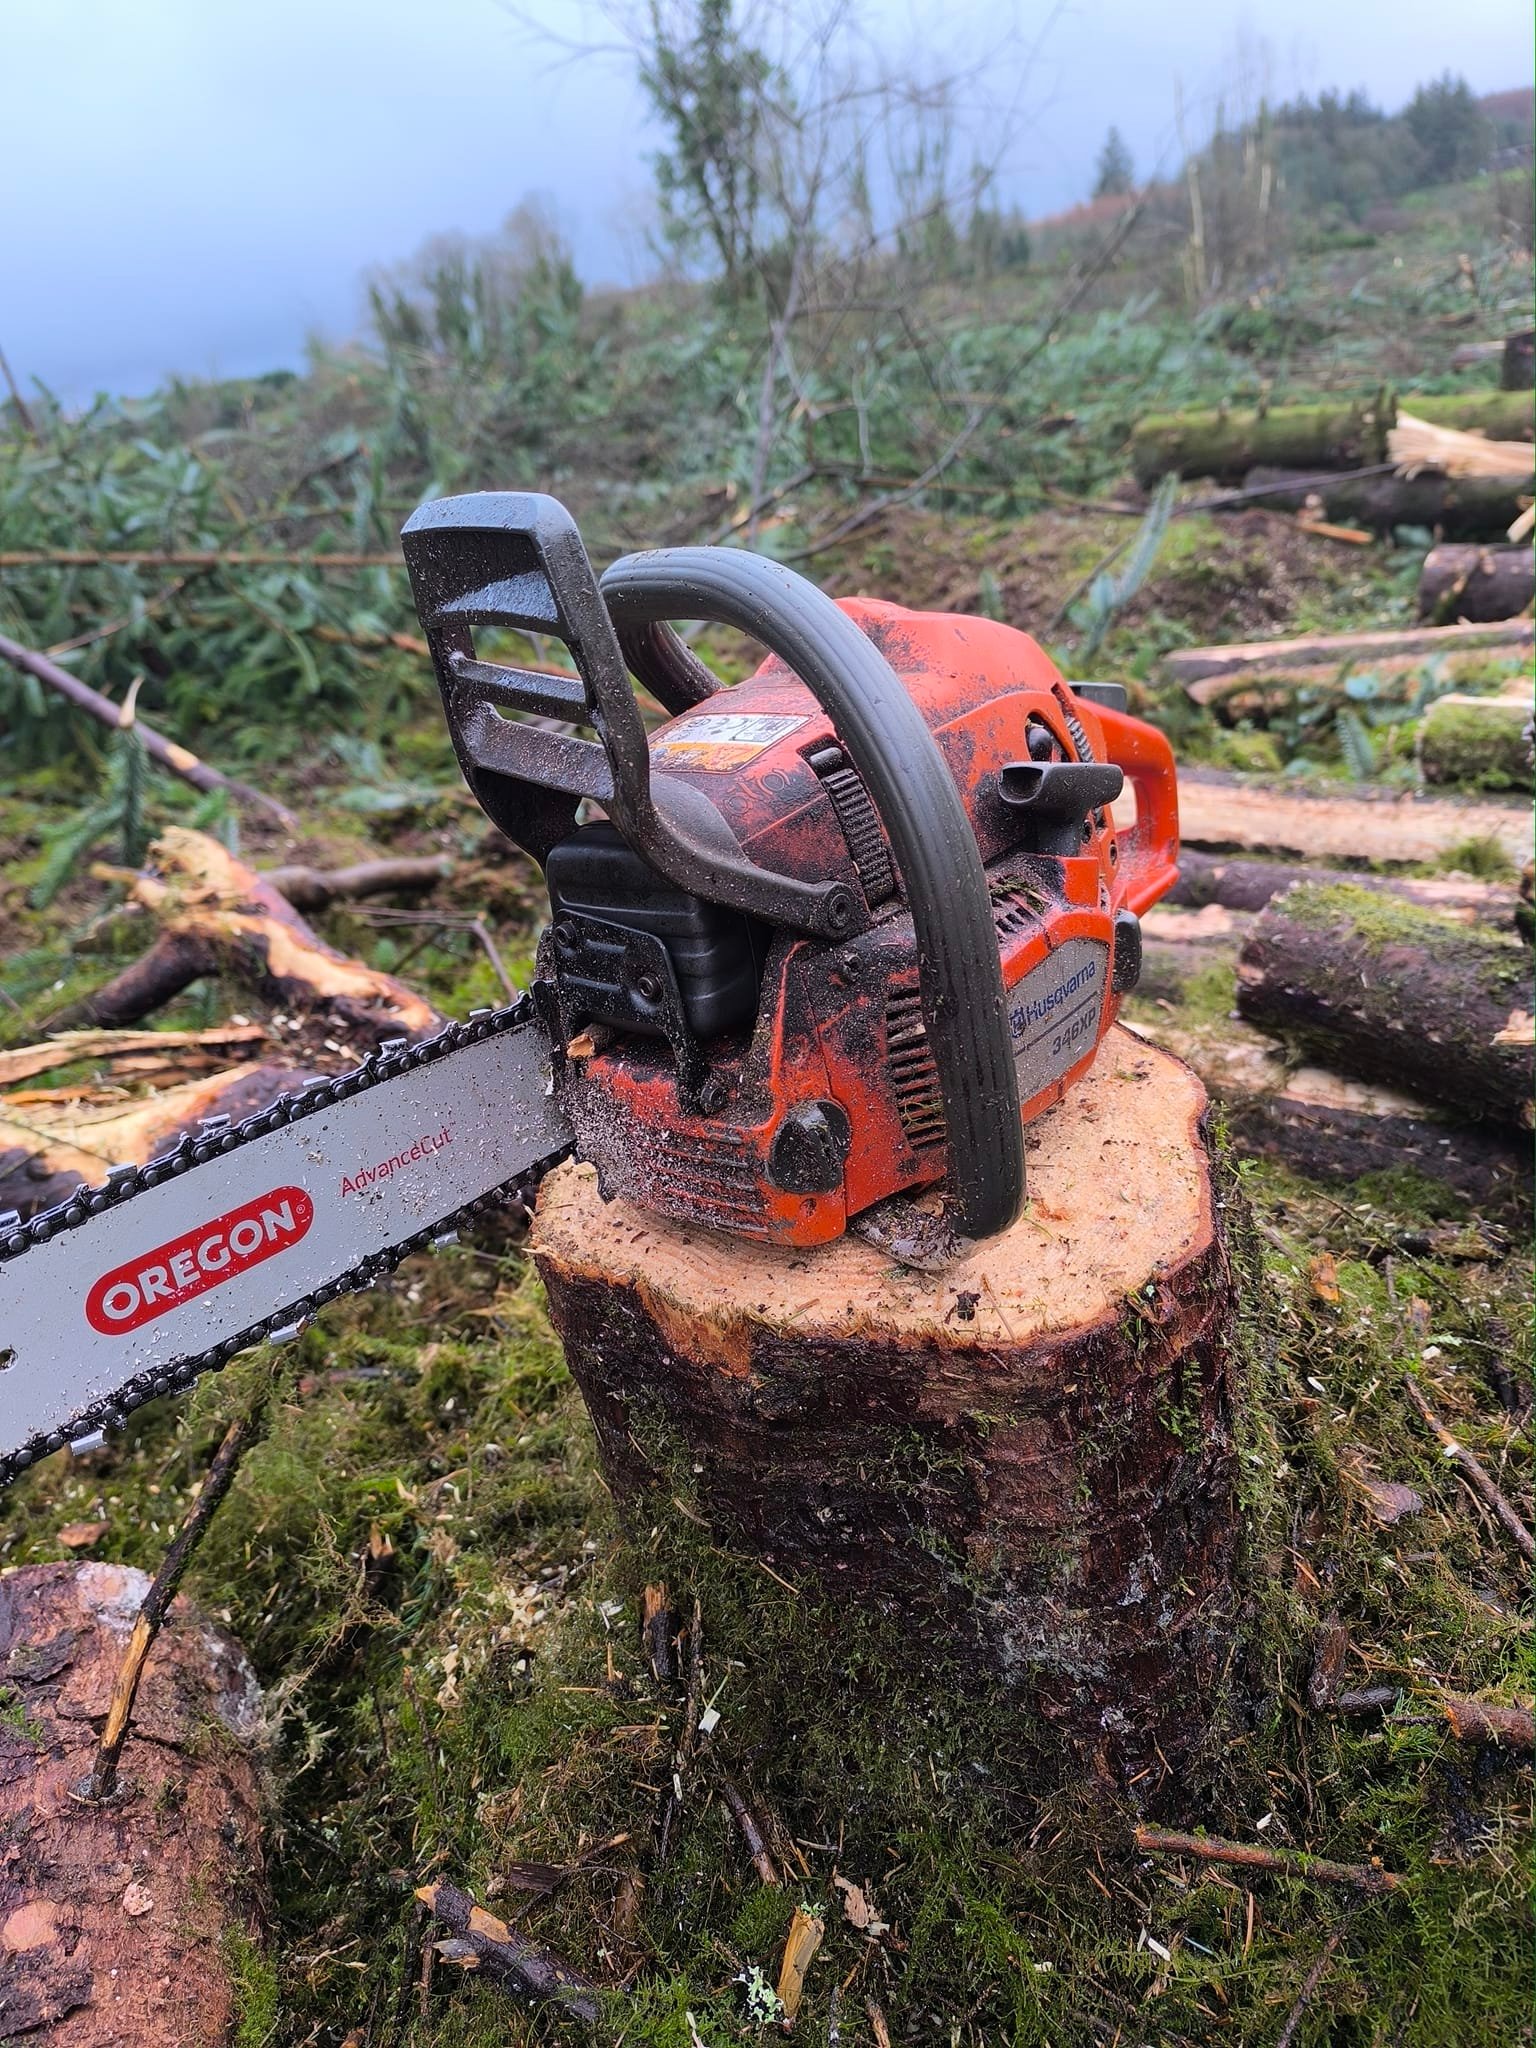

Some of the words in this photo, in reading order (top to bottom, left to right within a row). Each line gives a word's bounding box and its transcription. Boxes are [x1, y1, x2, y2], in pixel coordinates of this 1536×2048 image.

[1026, 961, 1096, 1026] Husqvarna
[1052, 1007, 1097, 1056] 346XP
[340, 1128, 454, 1198] AdvanceCut
[102, 1199, 297, 1320] OREGON
